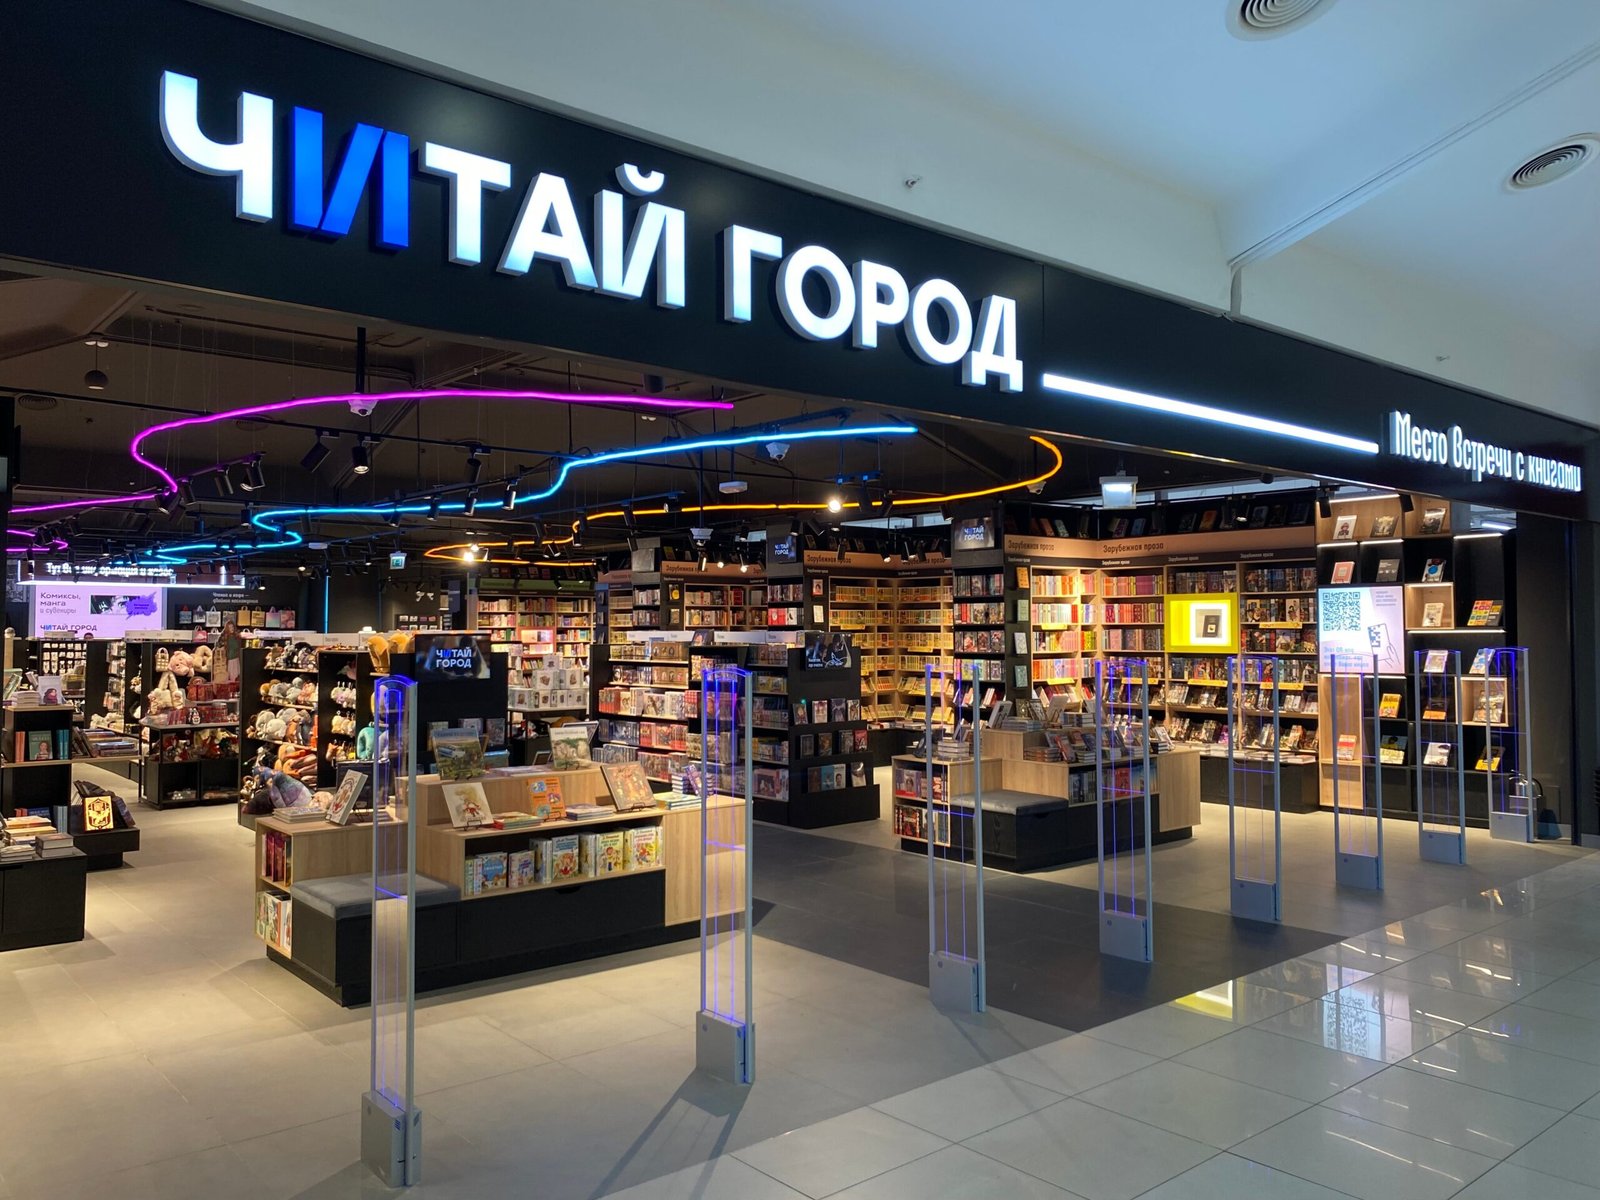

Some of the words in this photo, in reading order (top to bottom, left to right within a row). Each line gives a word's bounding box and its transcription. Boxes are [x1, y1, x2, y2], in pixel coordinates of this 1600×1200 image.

[159, 70, 686, 309] ЧИТАЙ
[724, 224, 1024, 393] ГОРОД
[1391, 410, 1448, 465] Место
[1450, 425, 1512, 482] Встречи
[1515, 451, 1525, 481] с
[1528, 455, 1581, 492] книгами
[1103, 544, 1142, 554] Зарубежная
[1144, 543, 1164, 551] проза
[46, 562, 61, 575] Тут
[40, 592, 81, 600] Комиксы,
[46, 607, 77, 615] сувениры
[40, 623, 68, 631] ЧИТАЙ
[436, 646, 472, 658] ЧИТАЙ
[436, 659, 472, 668] ГОРОД
